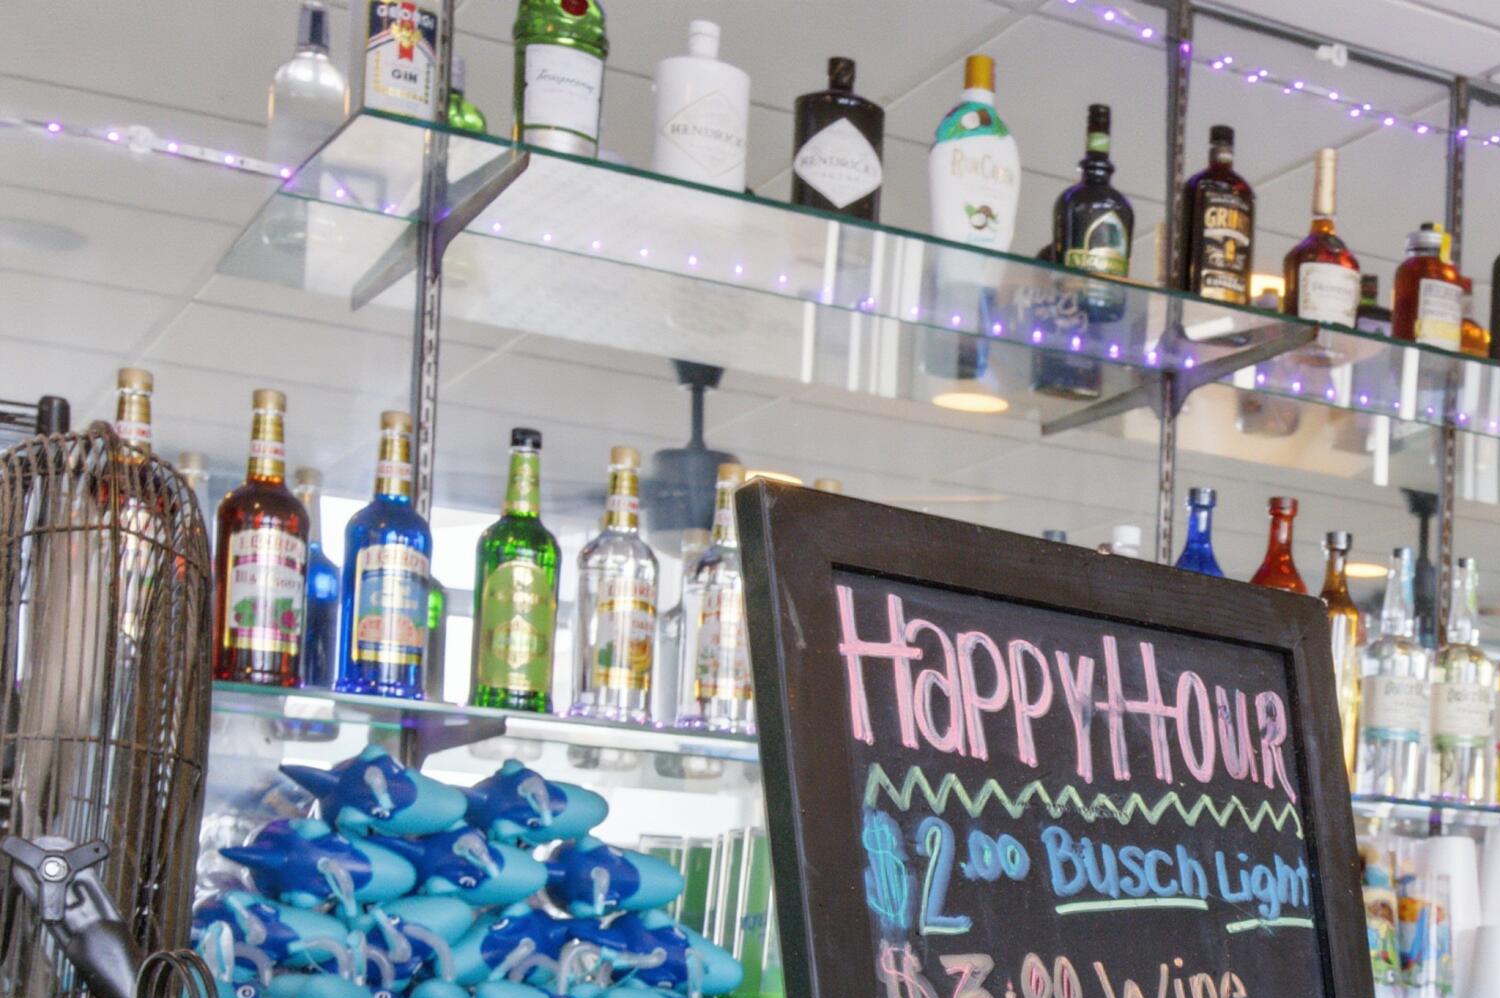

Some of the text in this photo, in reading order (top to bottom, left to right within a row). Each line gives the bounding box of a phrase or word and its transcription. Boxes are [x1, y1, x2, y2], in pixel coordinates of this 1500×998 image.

[391, 68, 418, 85] GIN
[862, 806, 1030, 936] $2.00
[1214, 848, 1311, 921] Light
